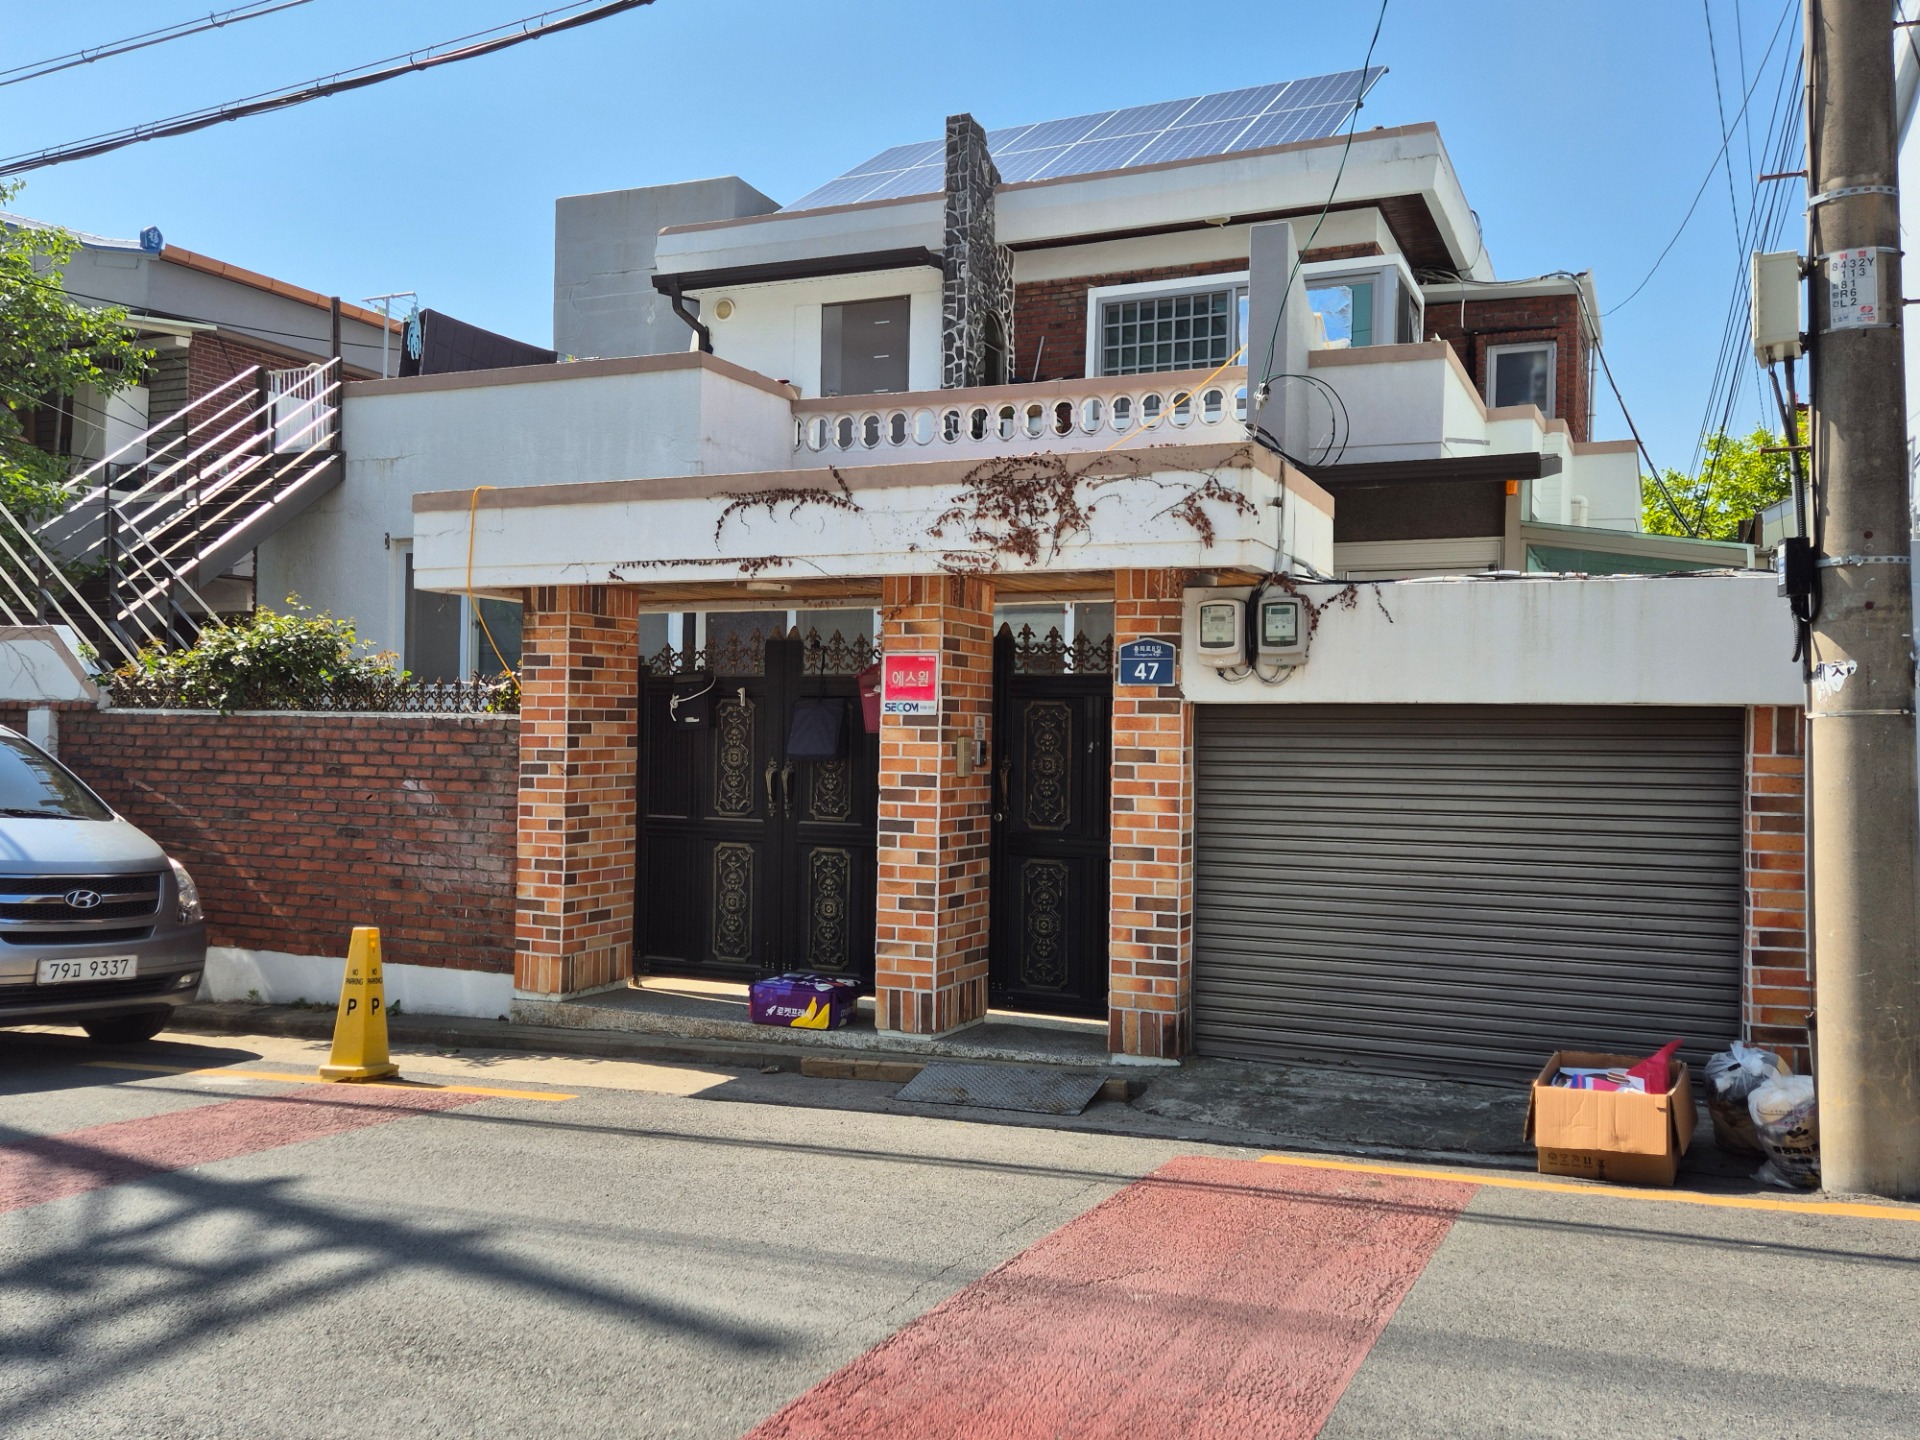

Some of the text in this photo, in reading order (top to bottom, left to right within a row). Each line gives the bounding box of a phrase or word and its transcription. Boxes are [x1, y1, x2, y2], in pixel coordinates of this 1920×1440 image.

[892, 670, 929, 687] 에스원
[1134, 662, 1159, 680] 47
[885, 702, 919, 712] SECOM
[50, 959, 129, 980] 79고 9337
